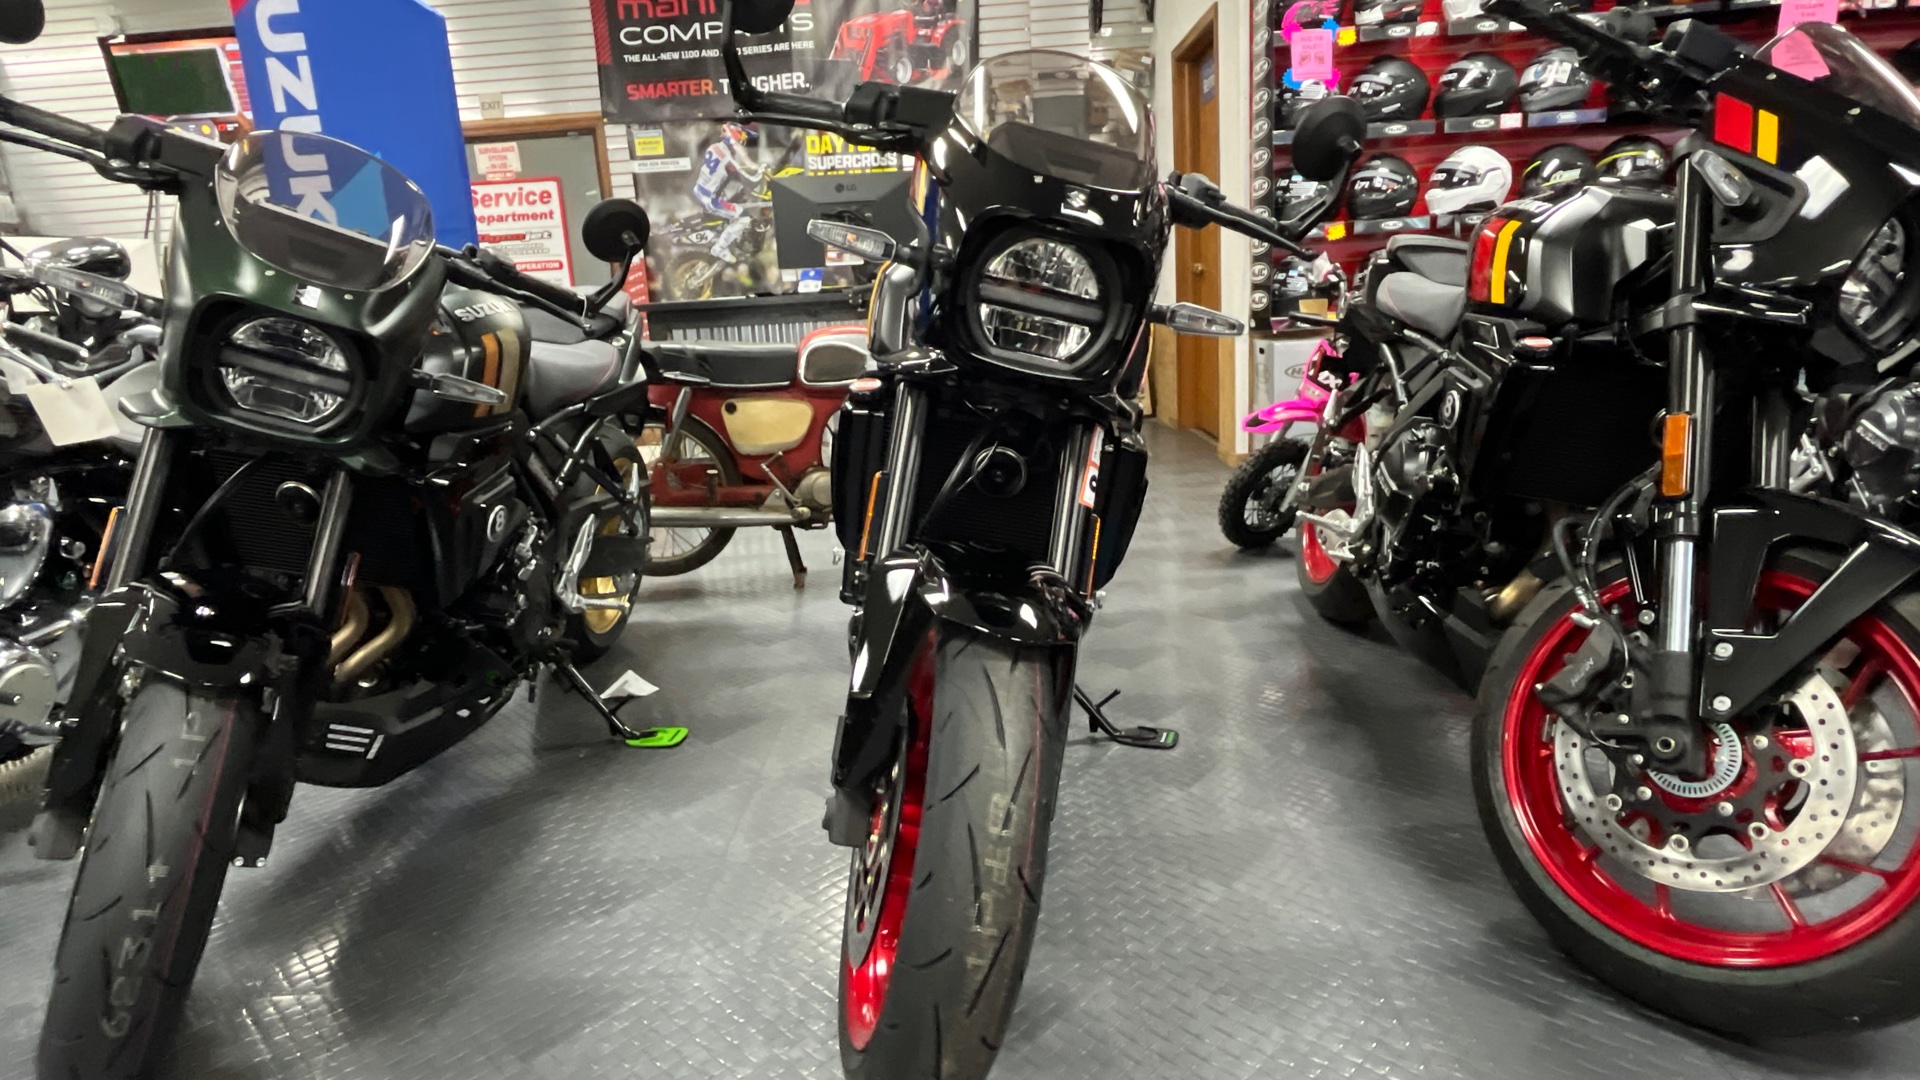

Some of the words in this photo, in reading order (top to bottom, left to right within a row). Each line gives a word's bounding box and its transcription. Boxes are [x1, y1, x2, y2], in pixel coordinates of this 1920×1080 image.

[619, 13, 815, 46] COMPS
[623, 54, 640, 63] THE
[641, 52, 679, 62] ALL-NEW
[681, 50, 699, 59] 1100
[701, 49, 719, 58] AND
[743, 46, 772, 56] SERIES
[773, 42, 790, 52] ARE
[791, 41, 815, 50] HERE
[626, 79, 718, 101] SMARTER.
[719, 72, 810, 95] TGHER.
[481, 101, 501, 111] EXIT
[808, 152, 898, 171] SUPERCROSS
[846, 183, 858, 192] LG
[471, 186, 553, 209] Service
[476, 209, 555, 226] epartment
[695, 231, 708, 242] 94
[516, 260, 560, 271] OPERATION
